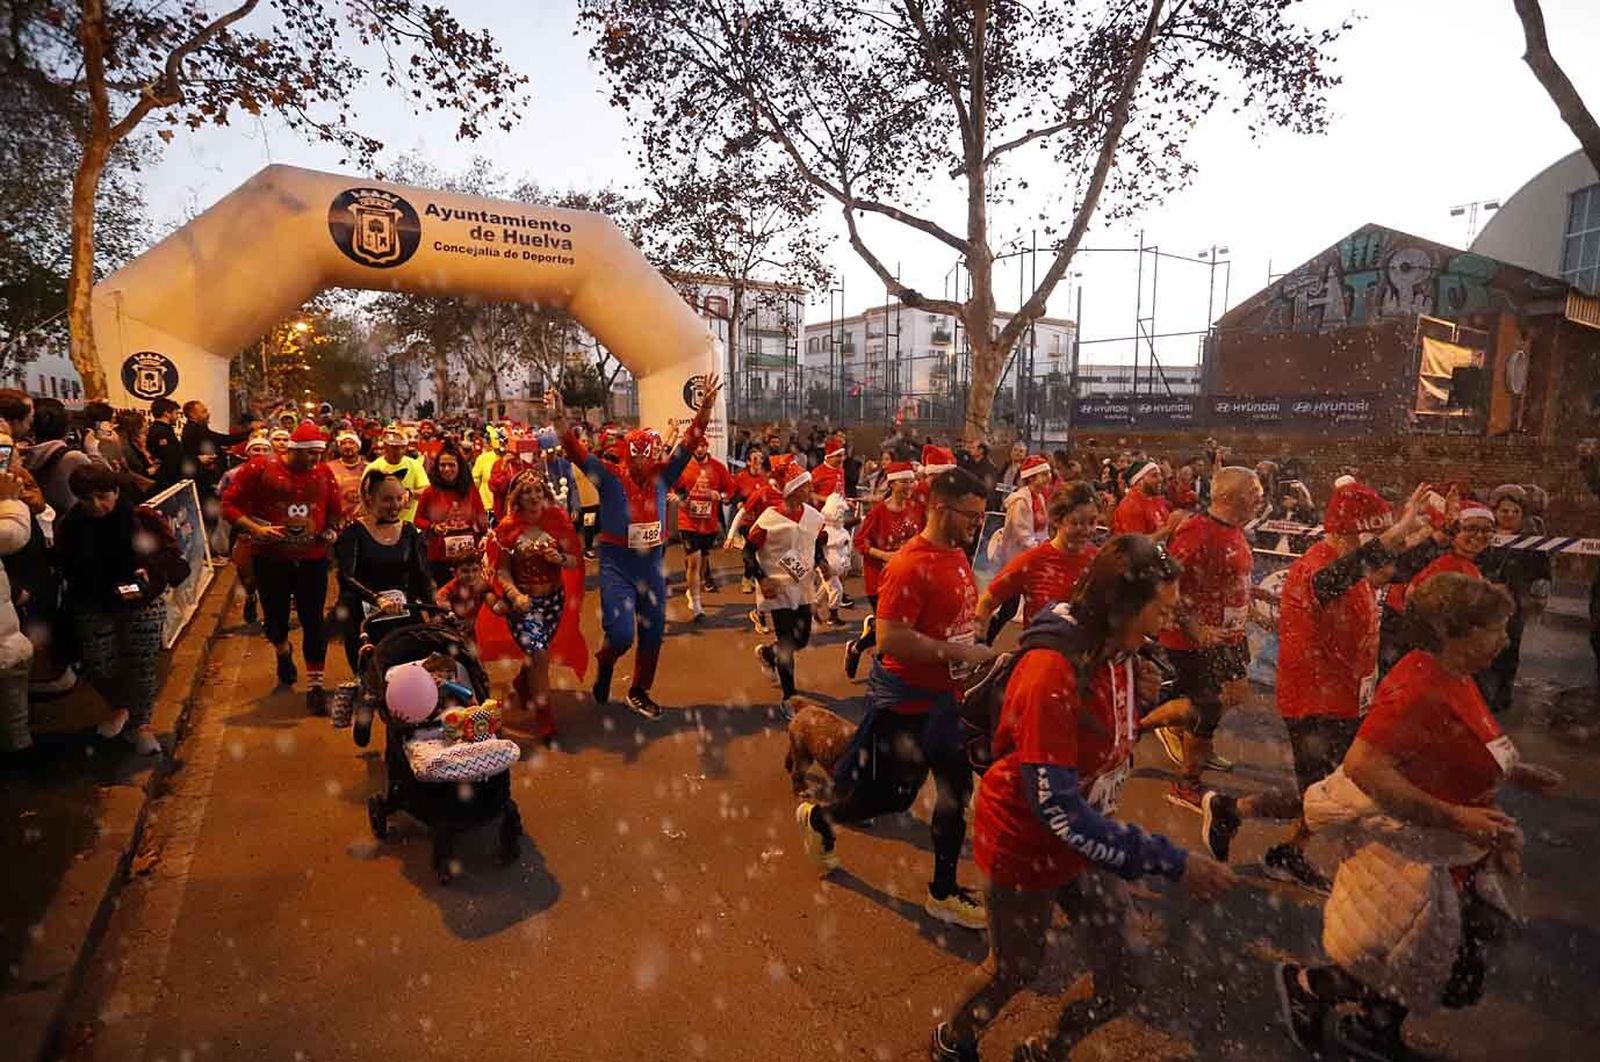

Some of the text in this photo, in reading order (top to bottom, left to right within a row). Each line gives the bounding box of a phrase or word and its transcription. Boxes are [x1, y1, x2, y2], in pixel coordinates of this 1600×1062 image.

[425, 203, 571, 232] Ayuntamiento
[470, 226, 573, 250] de Huelva
[504, 249, 518, 259] de
[522, 251, 575, 265] Deportes
[1233, 402, 1280, 412] HYUNDAI
[1314, 401, 1369, 411] HYUNDAI
[643, 529, 659, 540] 489
